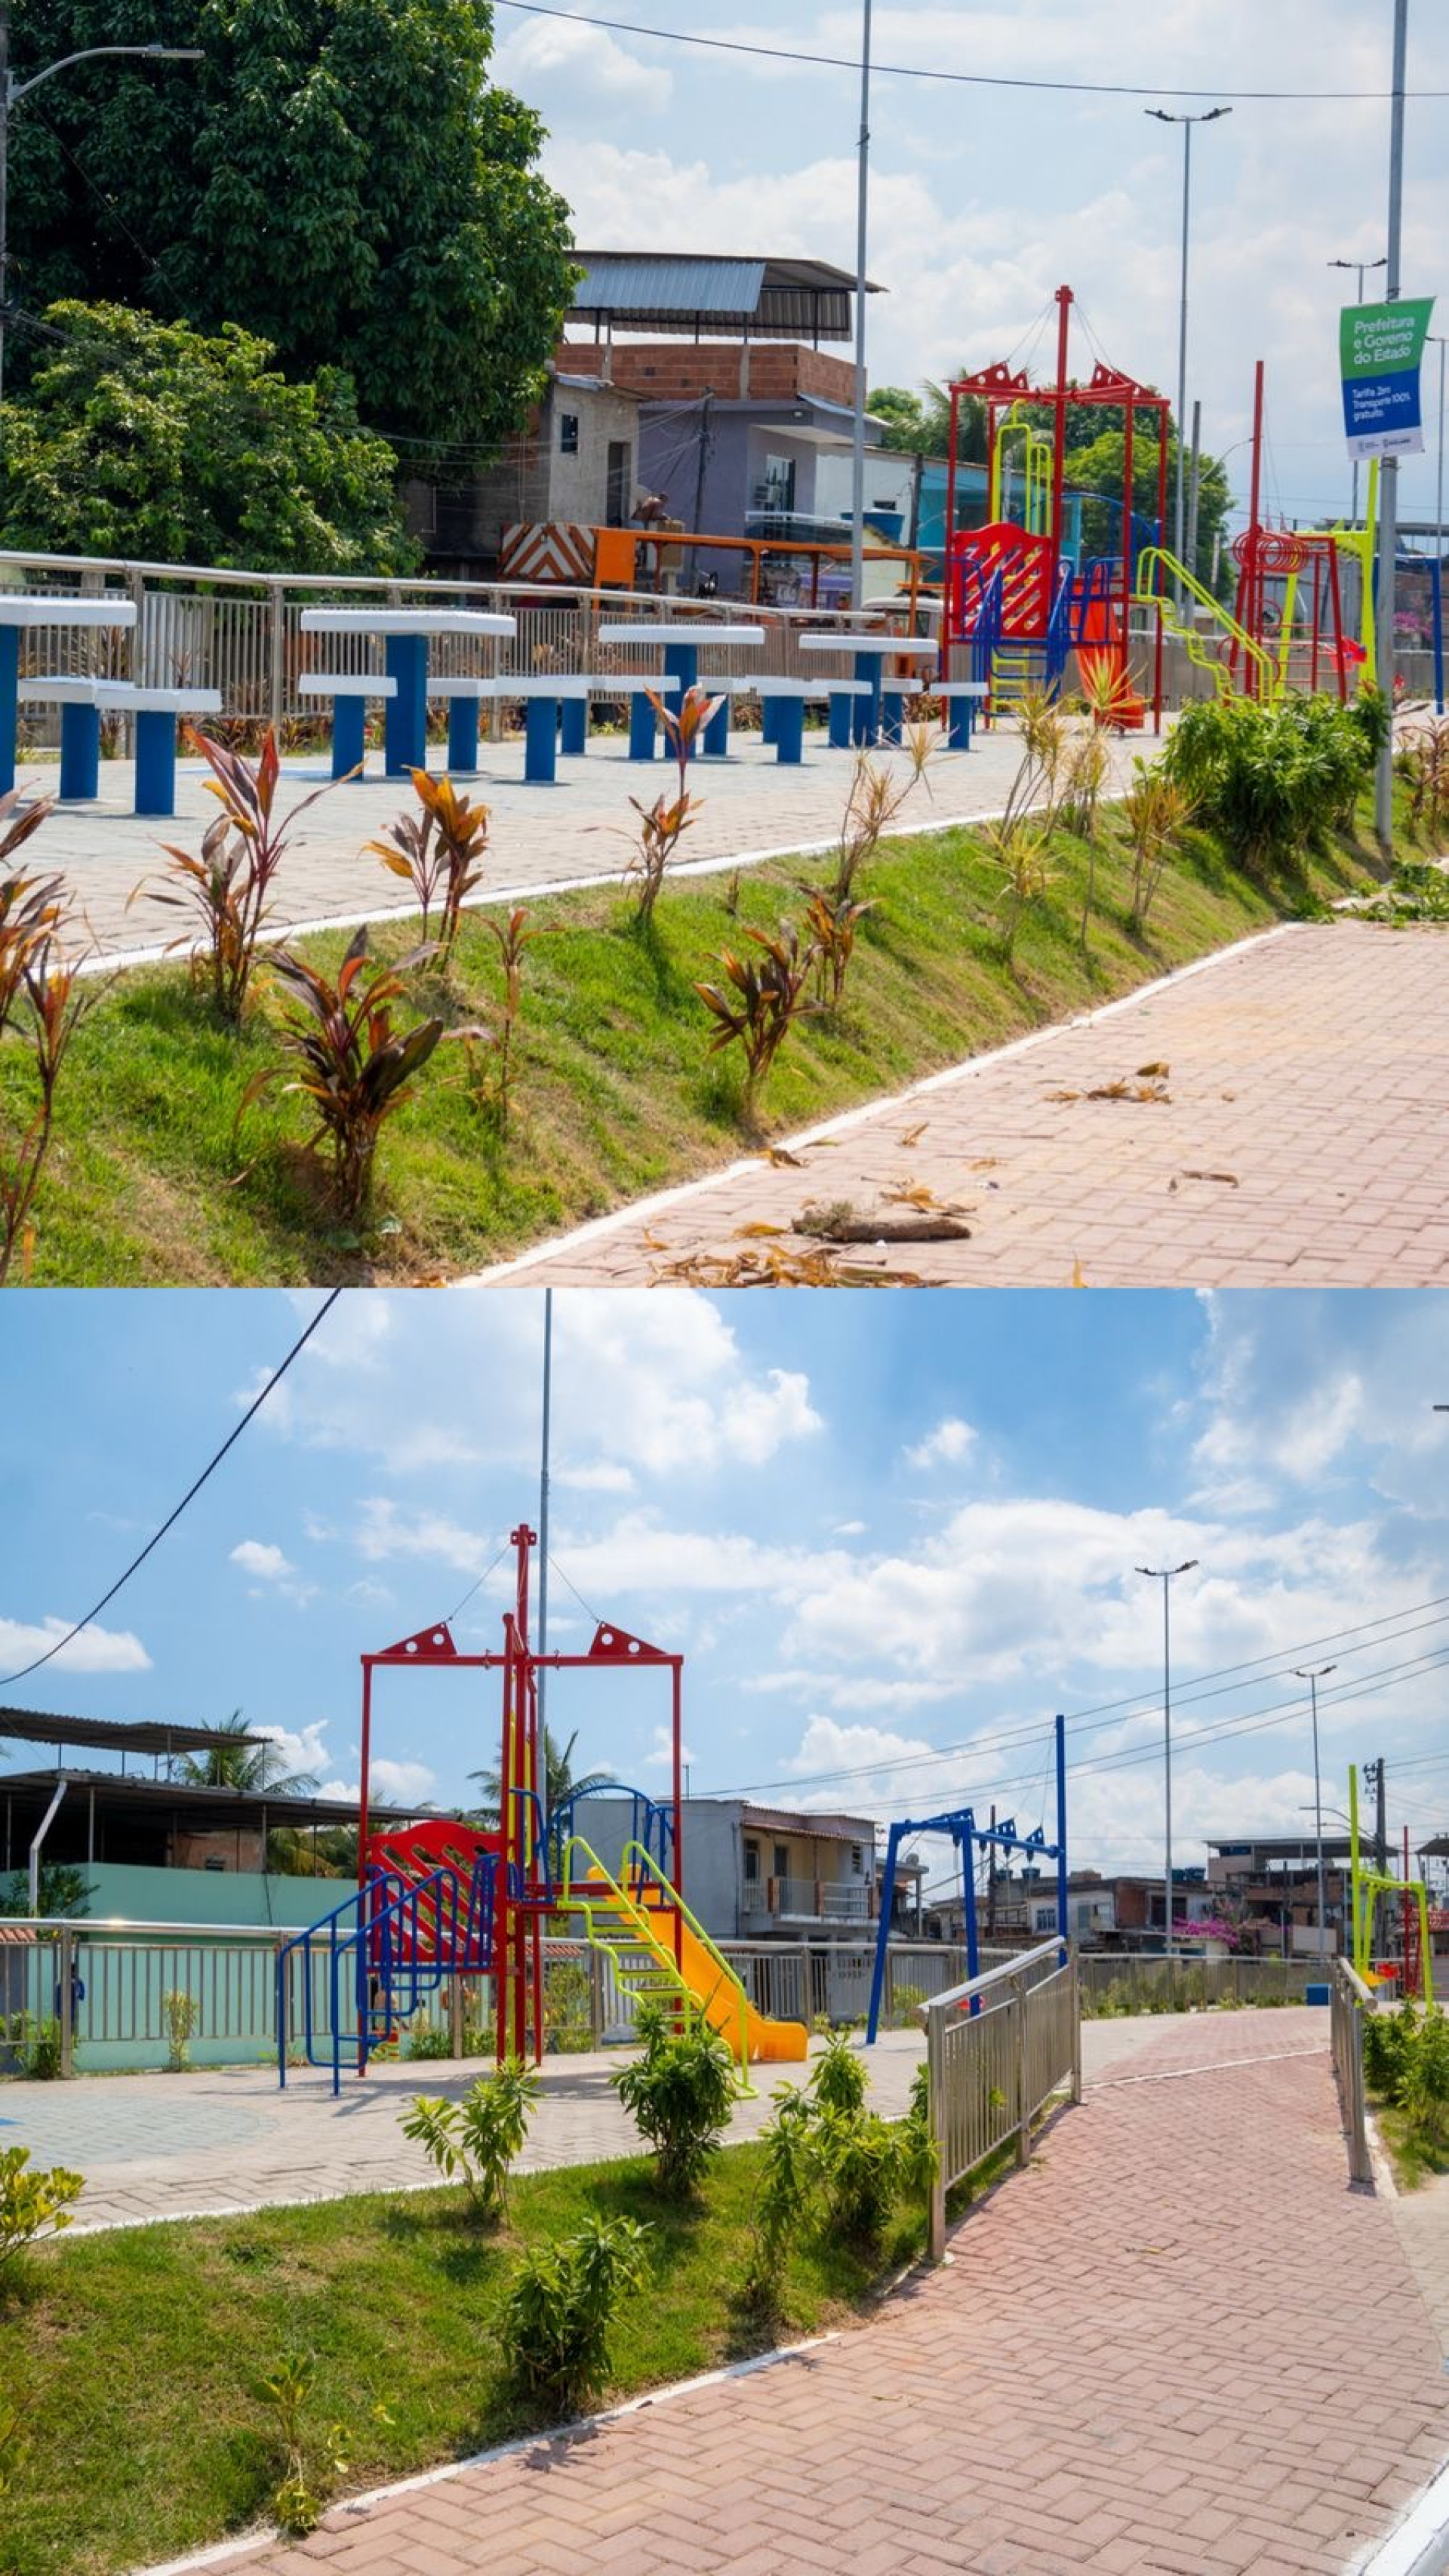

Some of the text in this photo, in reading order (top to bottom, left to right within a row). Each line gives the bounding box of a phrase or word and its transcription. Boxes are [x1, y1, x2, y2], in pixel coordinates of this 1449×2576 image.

[1355, 316, 1414, 334] Prefeitura
[1354, 344, 1411, 364] do Estado
